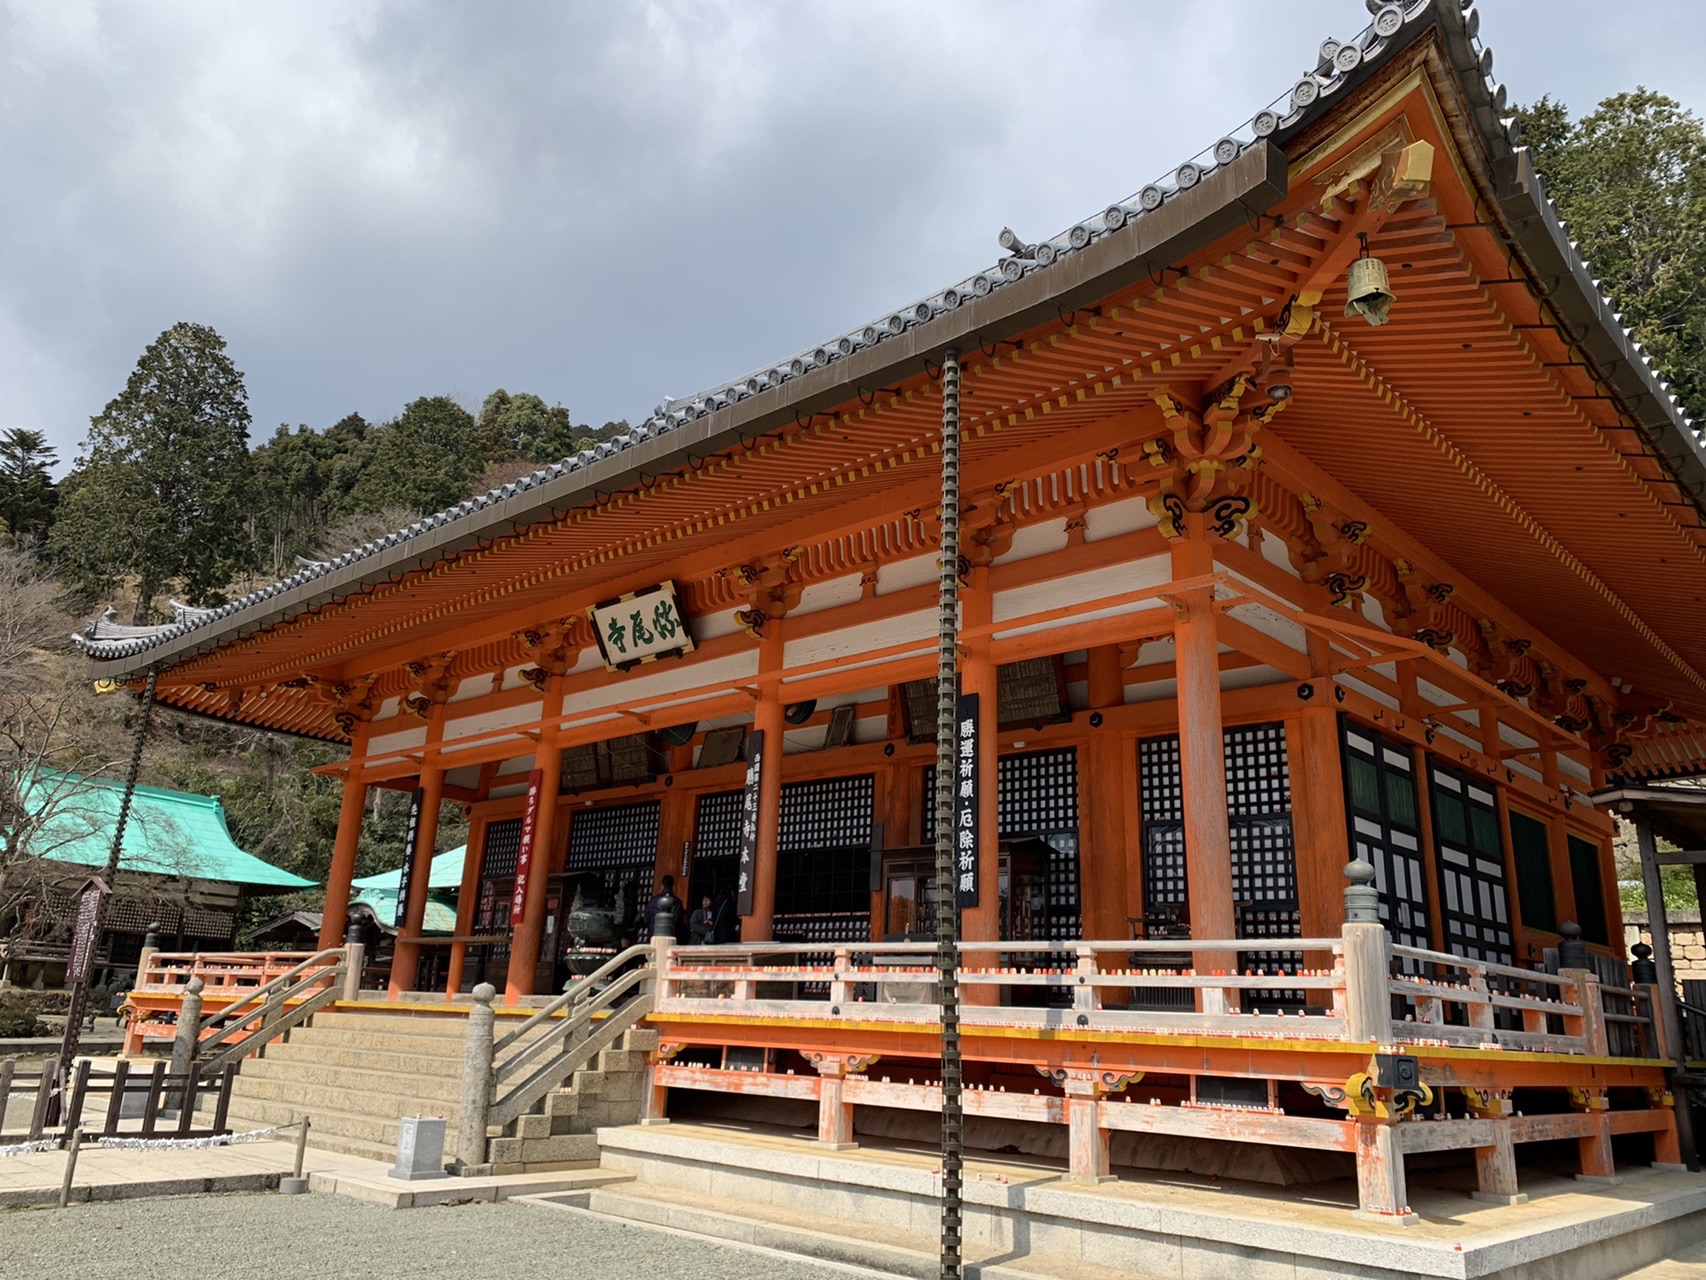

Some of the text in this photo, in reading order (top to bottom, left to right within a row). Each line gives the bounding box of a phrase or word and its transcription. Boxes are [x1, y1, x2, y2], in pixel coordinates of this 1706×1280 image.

[739, 766, 755, 893] 勝尾寺本堂
